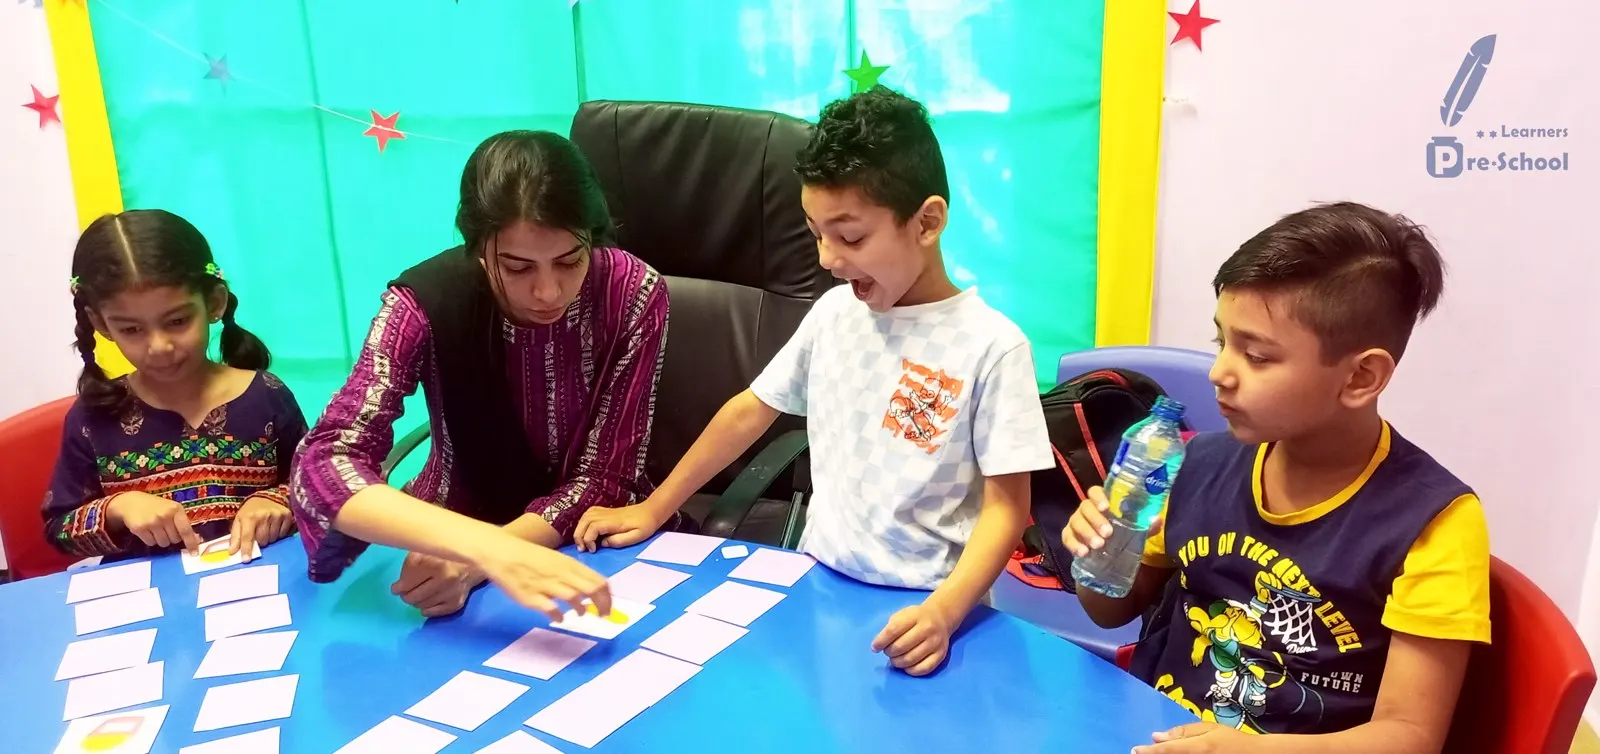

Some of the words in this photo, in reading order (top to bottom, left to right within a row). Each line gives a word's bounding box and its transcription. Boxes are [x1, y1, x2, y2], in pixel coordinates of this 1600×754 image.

[1178, 536, 1210, 567] YOU
[1217, 532, 1237, 557] ON
[1240, 535, 1279, 567] THE
[1314, 601, 1362, 653] LEVEL
[1301, 672, 1361, 693] FUTURE
